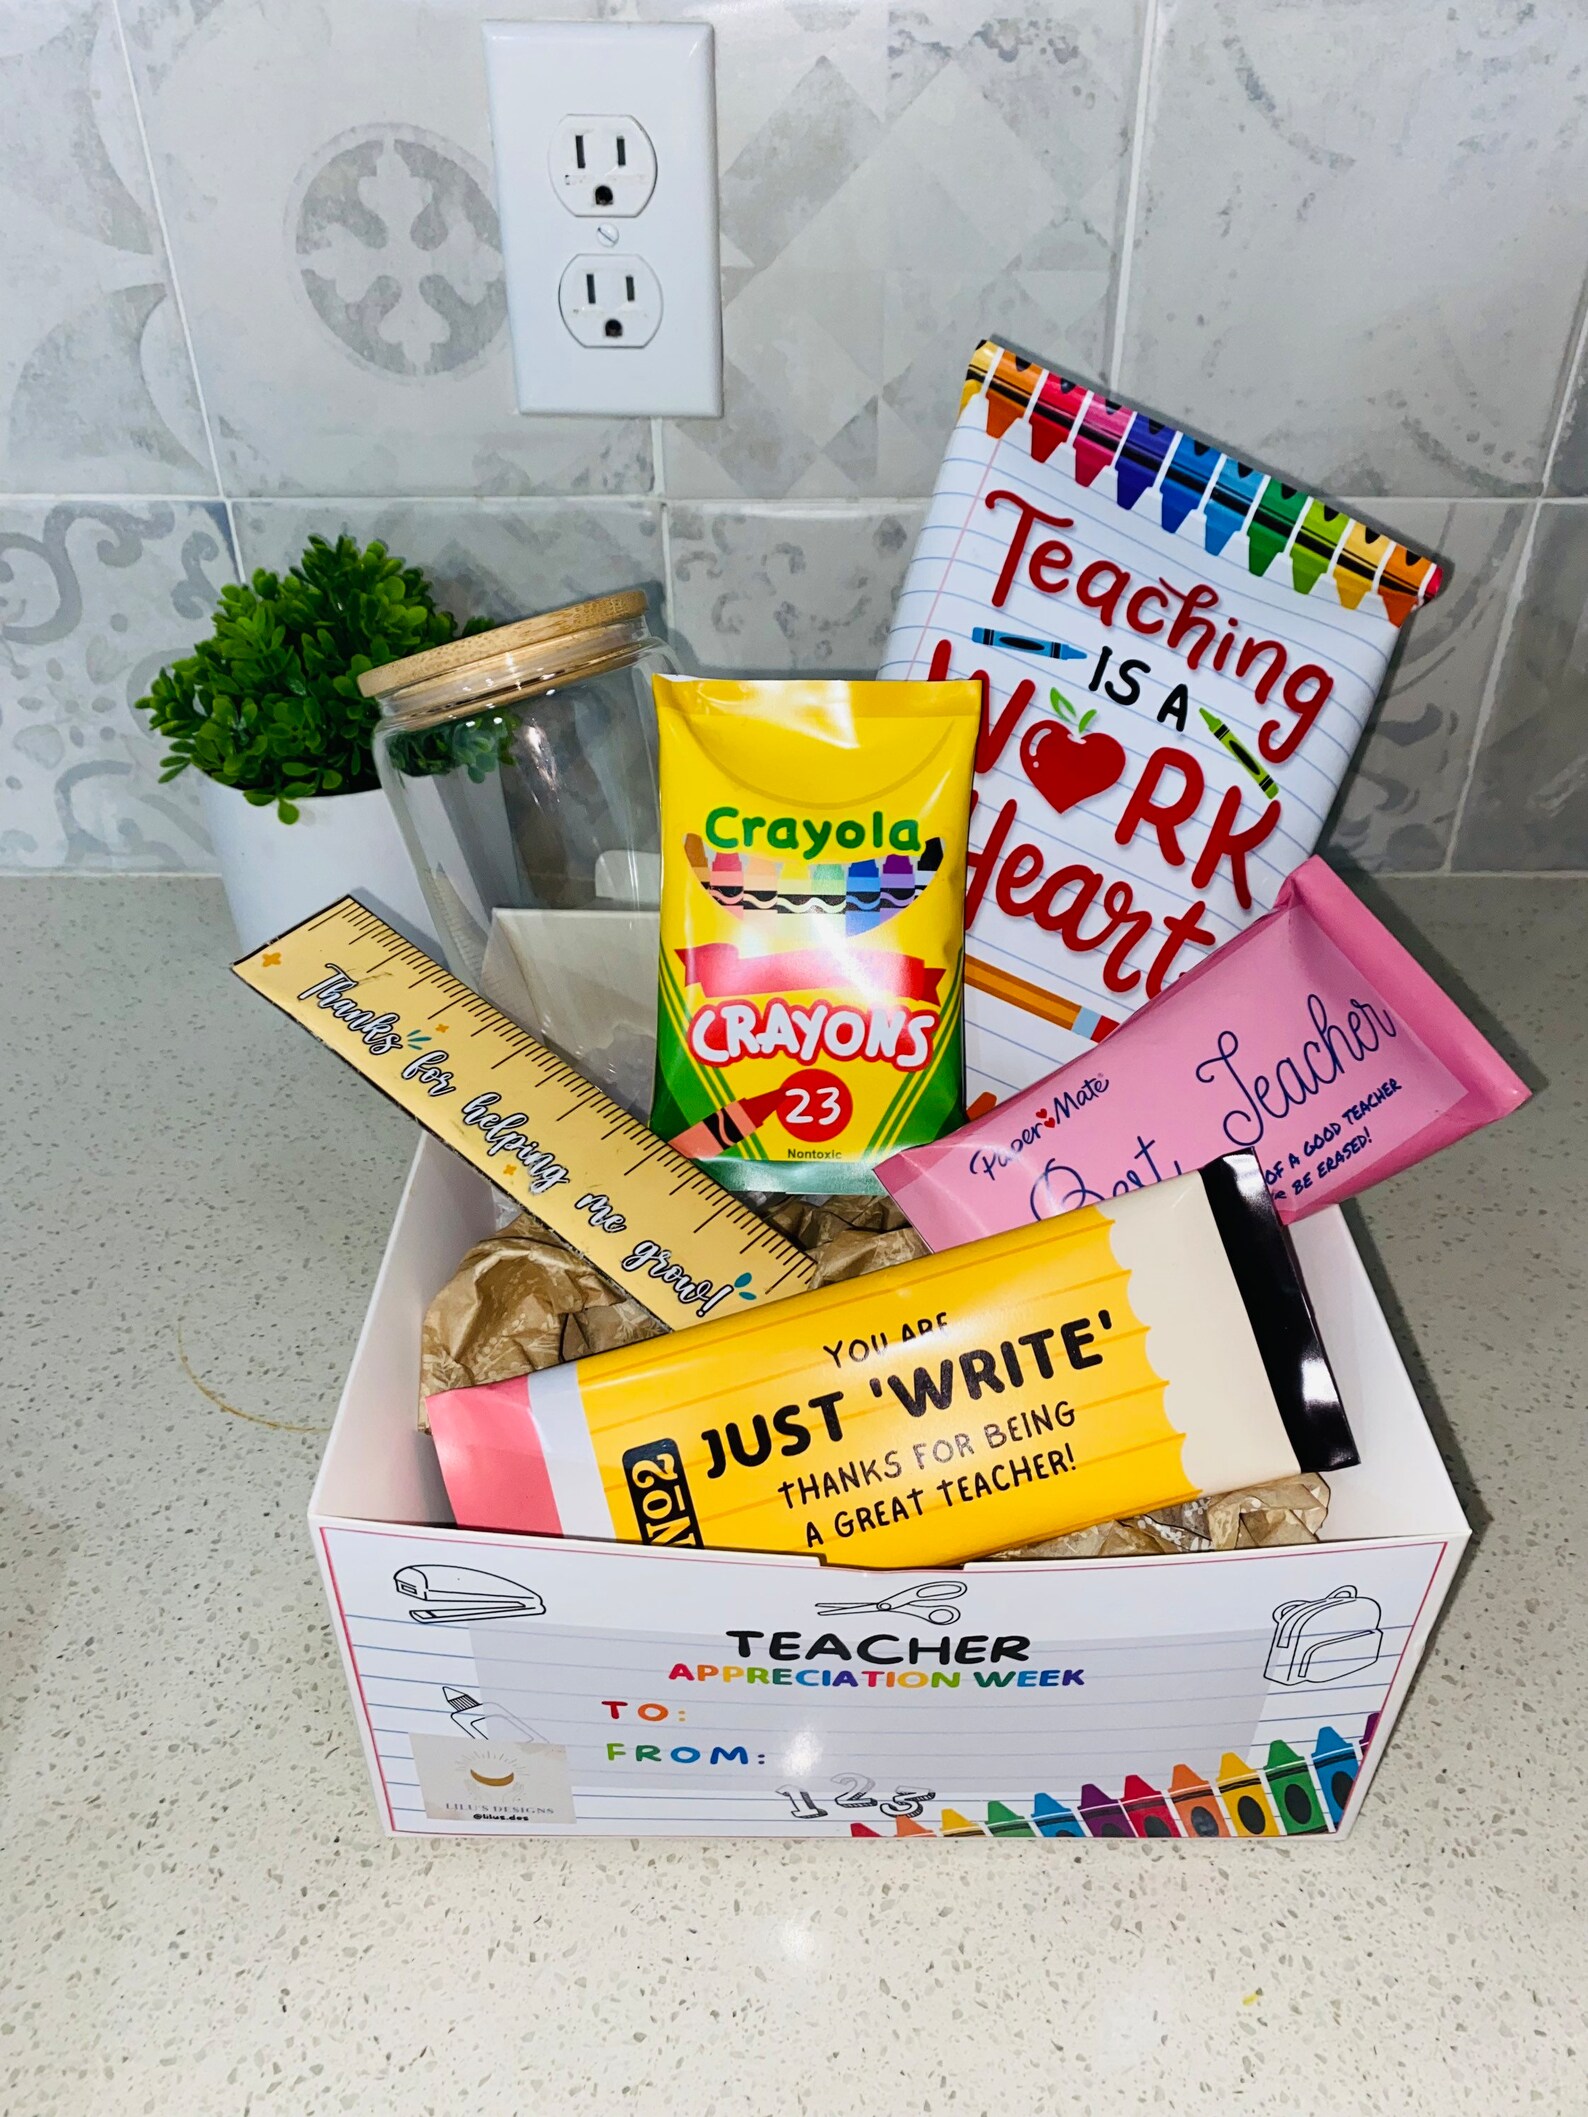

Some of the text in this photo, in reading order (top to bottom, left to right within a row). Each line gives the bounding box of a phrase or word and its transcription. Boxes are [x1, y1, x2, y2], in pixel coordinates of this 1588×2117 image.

[984, 489, 1334, 764] Teaching
[1088, 646, 1189, 732] IS A
[705, 806, 921, 859] Crayola
[690, 999, 938, 1070] CRAYONS
[1195, 993, 1398, 1147] Teacher
[297, 963, 735, 1318] Thanks for helping me grow!
[784, 1086, 842, 1126] 23
[1264, 1077, 1403, 1186] OF A GOOD TEACHER
[787, 1148, 843, 1160] Nontoxic
[1291, 1125, 1373, 1196] BE ERASED!
[822, 1332, 889, 1369] YOU
[701, 1309, 1113, 1480] JUST 'WRITE'
[777, 1400, 1077, 1510] THANKS FOR BEING
[805, 1442, 1078, 1548] A GREAT TEACHER!
[668, 1662, 1085, 1689] APPRECIATION WEEK
[726, 1630, 1031, 1666] TEACHER
[601, 1700, 687, 1722] TO:
[606, 1742, 766, 1766] FROM:
[493, 1805, 554, 1814] DESIGNS
